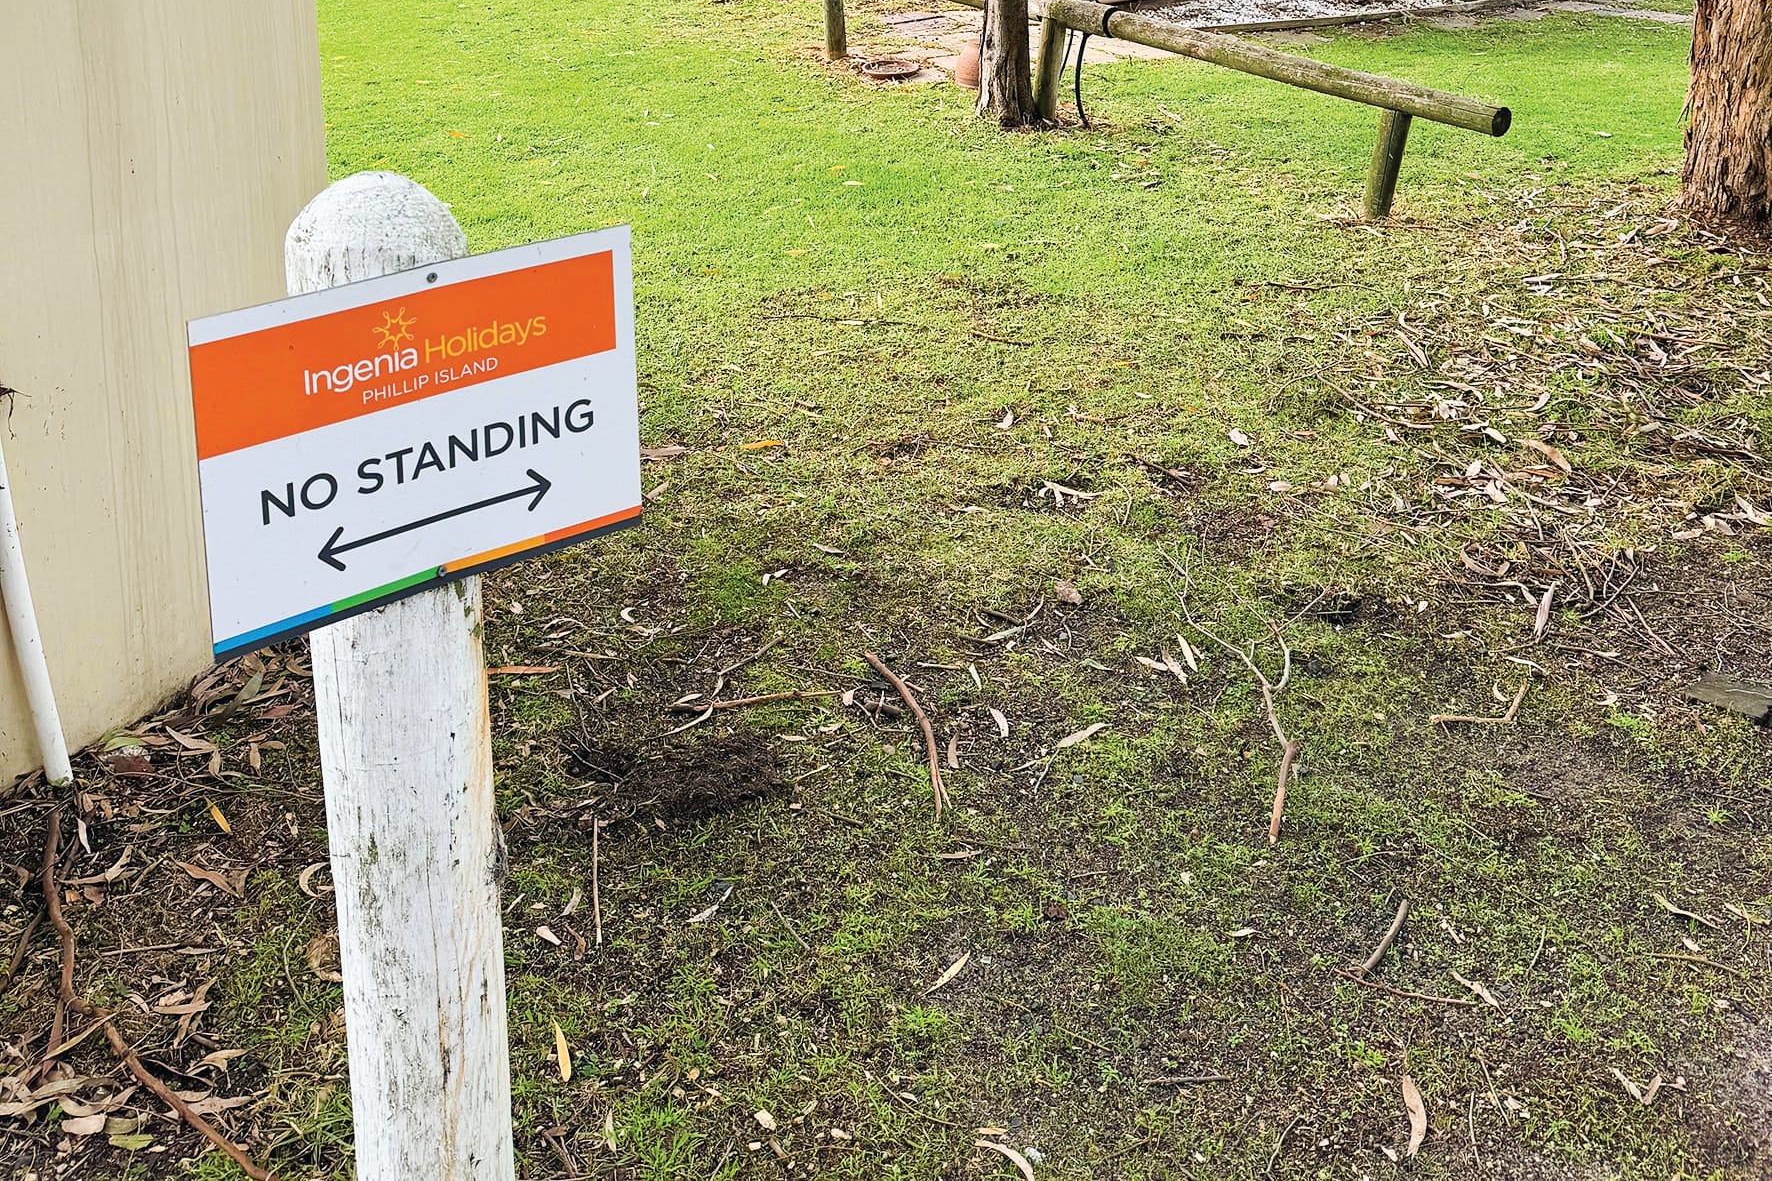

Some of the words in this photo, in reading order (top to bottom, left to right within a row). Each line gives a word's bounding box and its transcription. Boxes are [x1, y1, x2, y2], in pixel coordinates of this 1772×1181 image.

[303, 347, 419, 396] Ingenia
[424, 315, 548, 364] Holidays
[362, 374, 430, 405] PHILLIP
[434, 356, 499, 386] ISLAND
[260, 481, 339, 527] NO
[357, 397, 596, 496] STANDING
